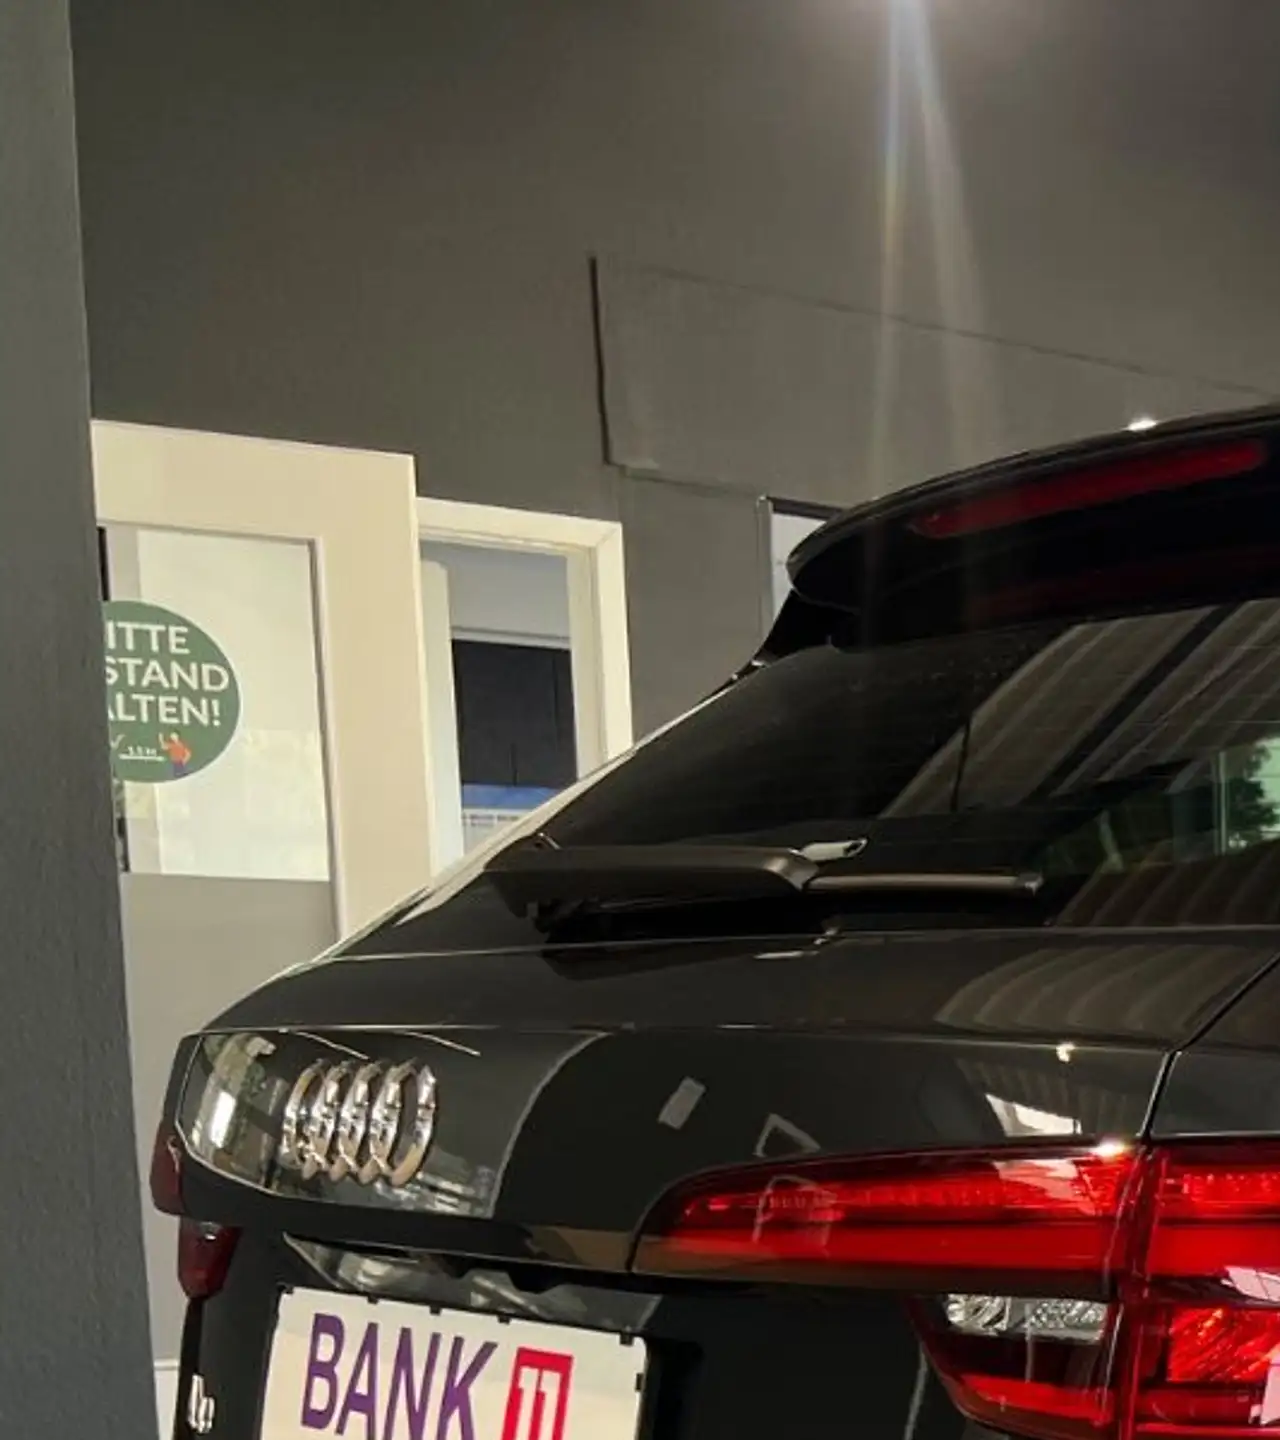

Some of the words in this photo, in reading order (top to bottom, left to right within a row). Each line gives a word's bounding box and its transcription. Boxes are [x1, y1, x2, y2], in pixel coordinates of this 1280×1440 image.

[106, 620, 190, 655] ITTE
[104, 655, 229, 691] STAND
[107, 692, 221, 727] LTEN!
